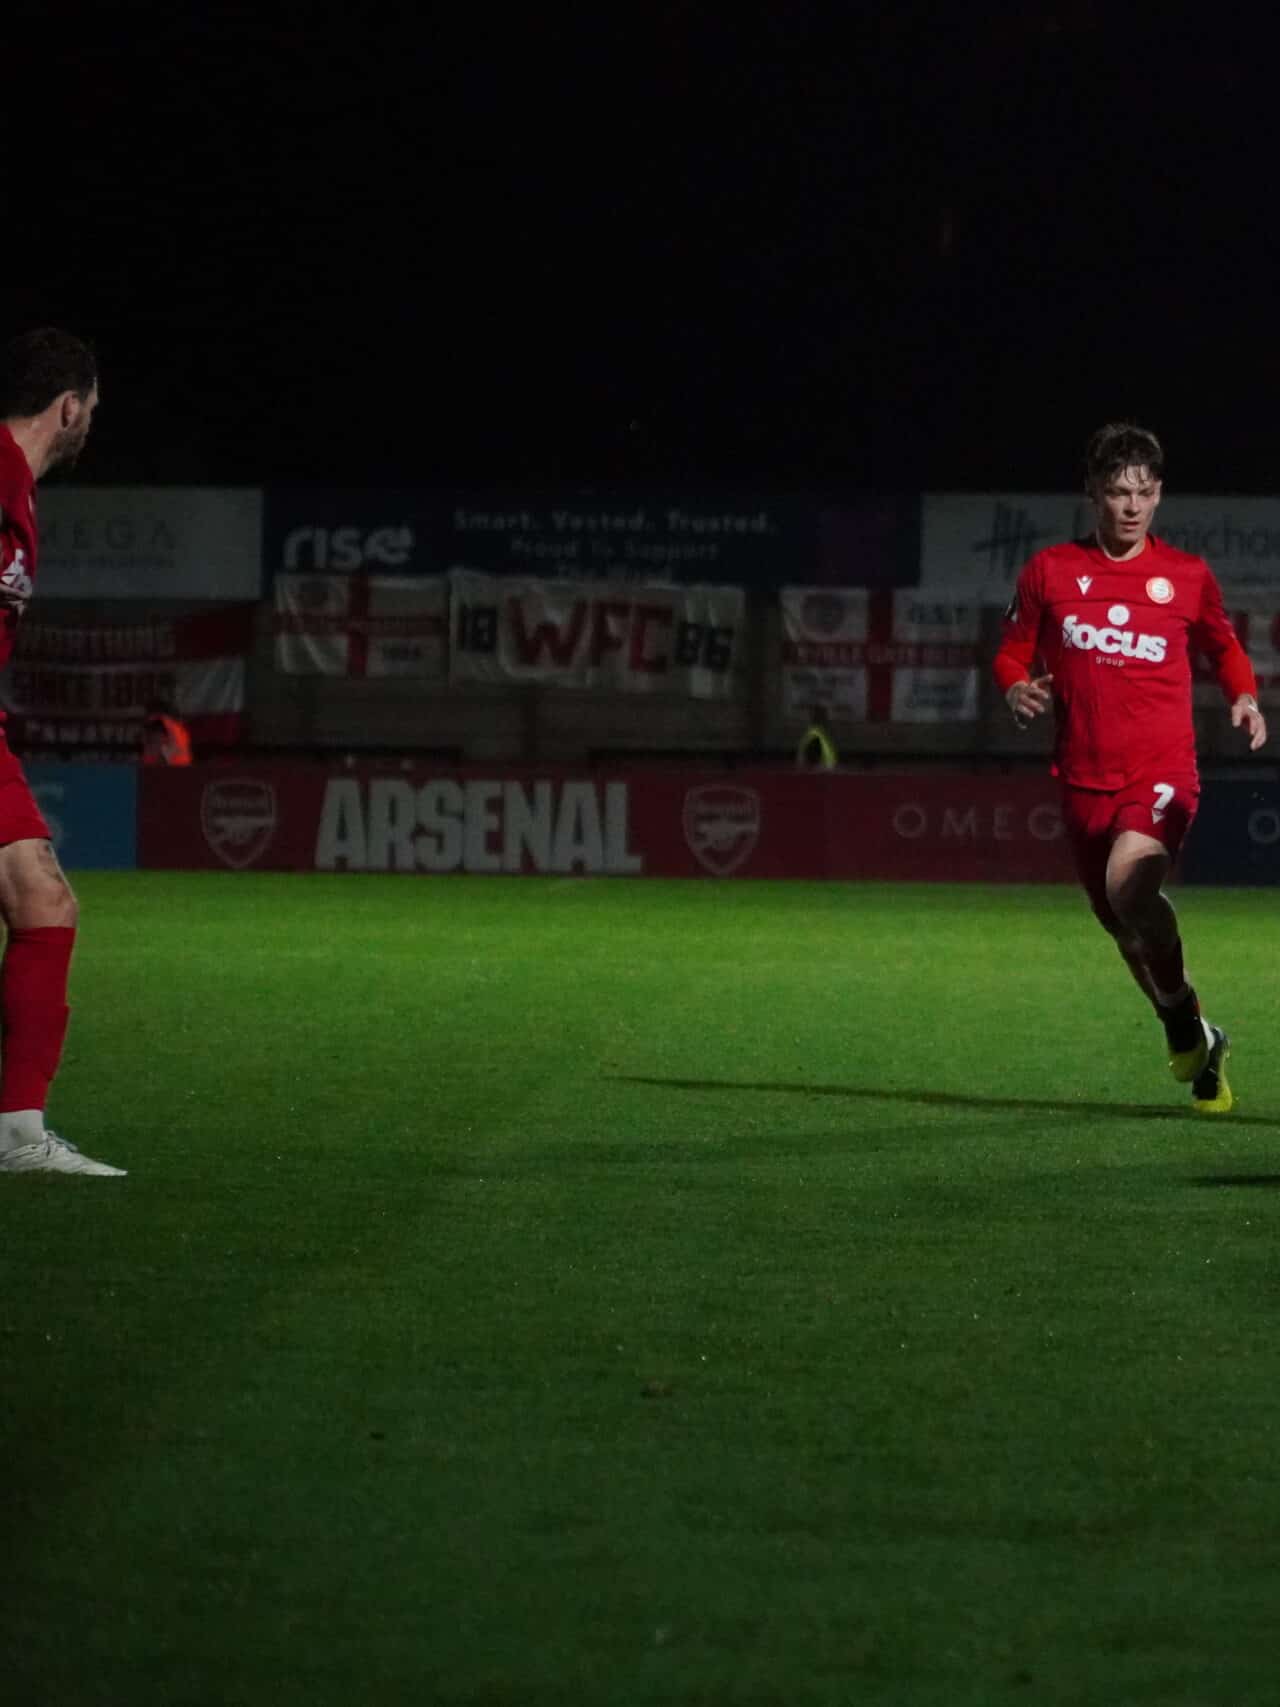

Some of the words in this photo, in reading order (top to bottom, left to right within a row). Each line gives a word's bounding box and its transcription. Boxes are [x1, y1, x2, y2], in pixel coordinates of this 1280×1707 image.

[666, 507, 780, 534] Trusted.
[283, 523, 414, 572] rise
[507, 597, 673, 672] WFC
[1063, 615, 1168, 662] focus
[1096, 655, 1125, 667] group
[315, 777, 643, 874] ARSENAL
[892, 802, 1063, 840] OMEG
